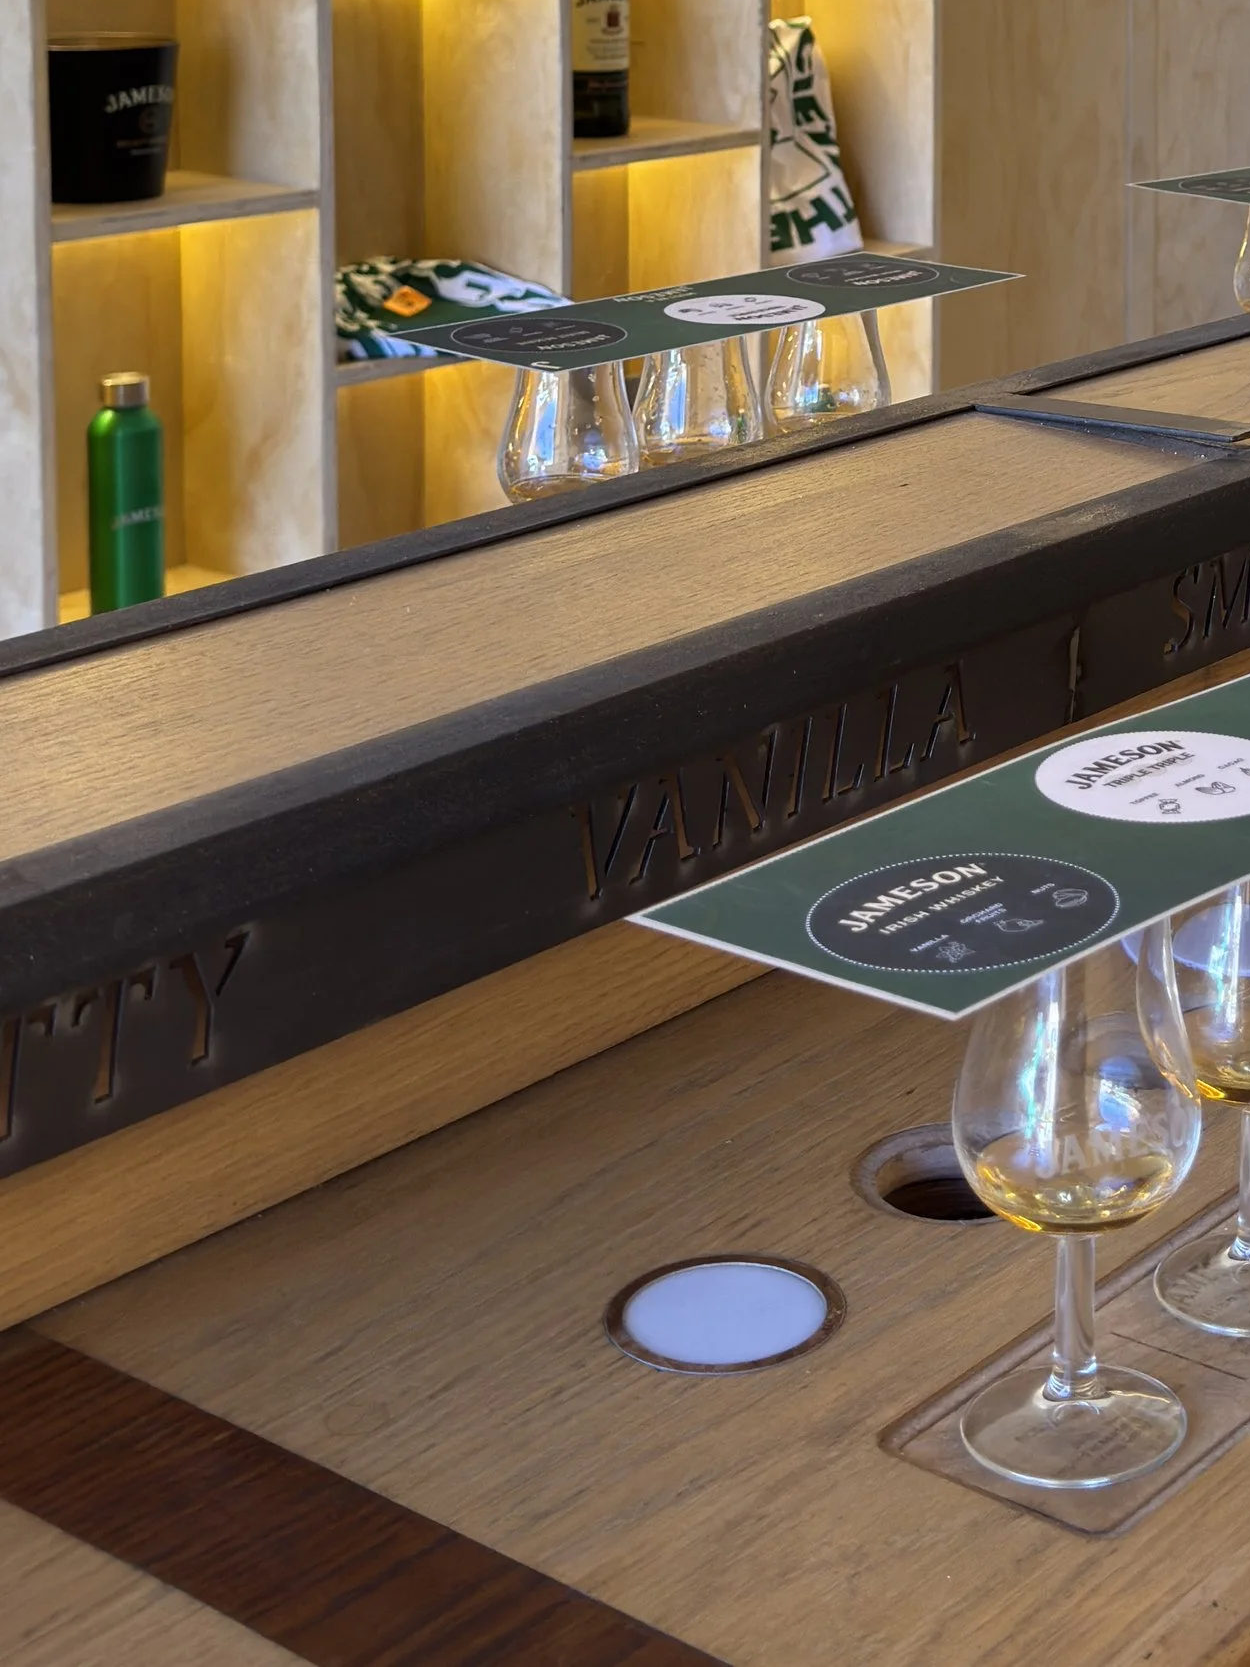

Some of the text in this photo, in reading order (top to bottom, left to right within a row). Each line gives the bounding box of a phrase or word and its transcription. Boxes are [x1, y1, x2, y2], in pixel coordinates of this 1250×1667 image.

[568, 658, 977, 905] VANILLA
[1065, 739, 1185, 790] JAMESON
[1102, 751, 1196, 789] TRIPLE TRIPLE
[1174, 773, 1206, 787] ALMOND
[838, 862, 989, 933] JAMESON
[878, 875, 1005, 936] IRISH WHISKEY
[909, 934, 950, 952] VANILLA
